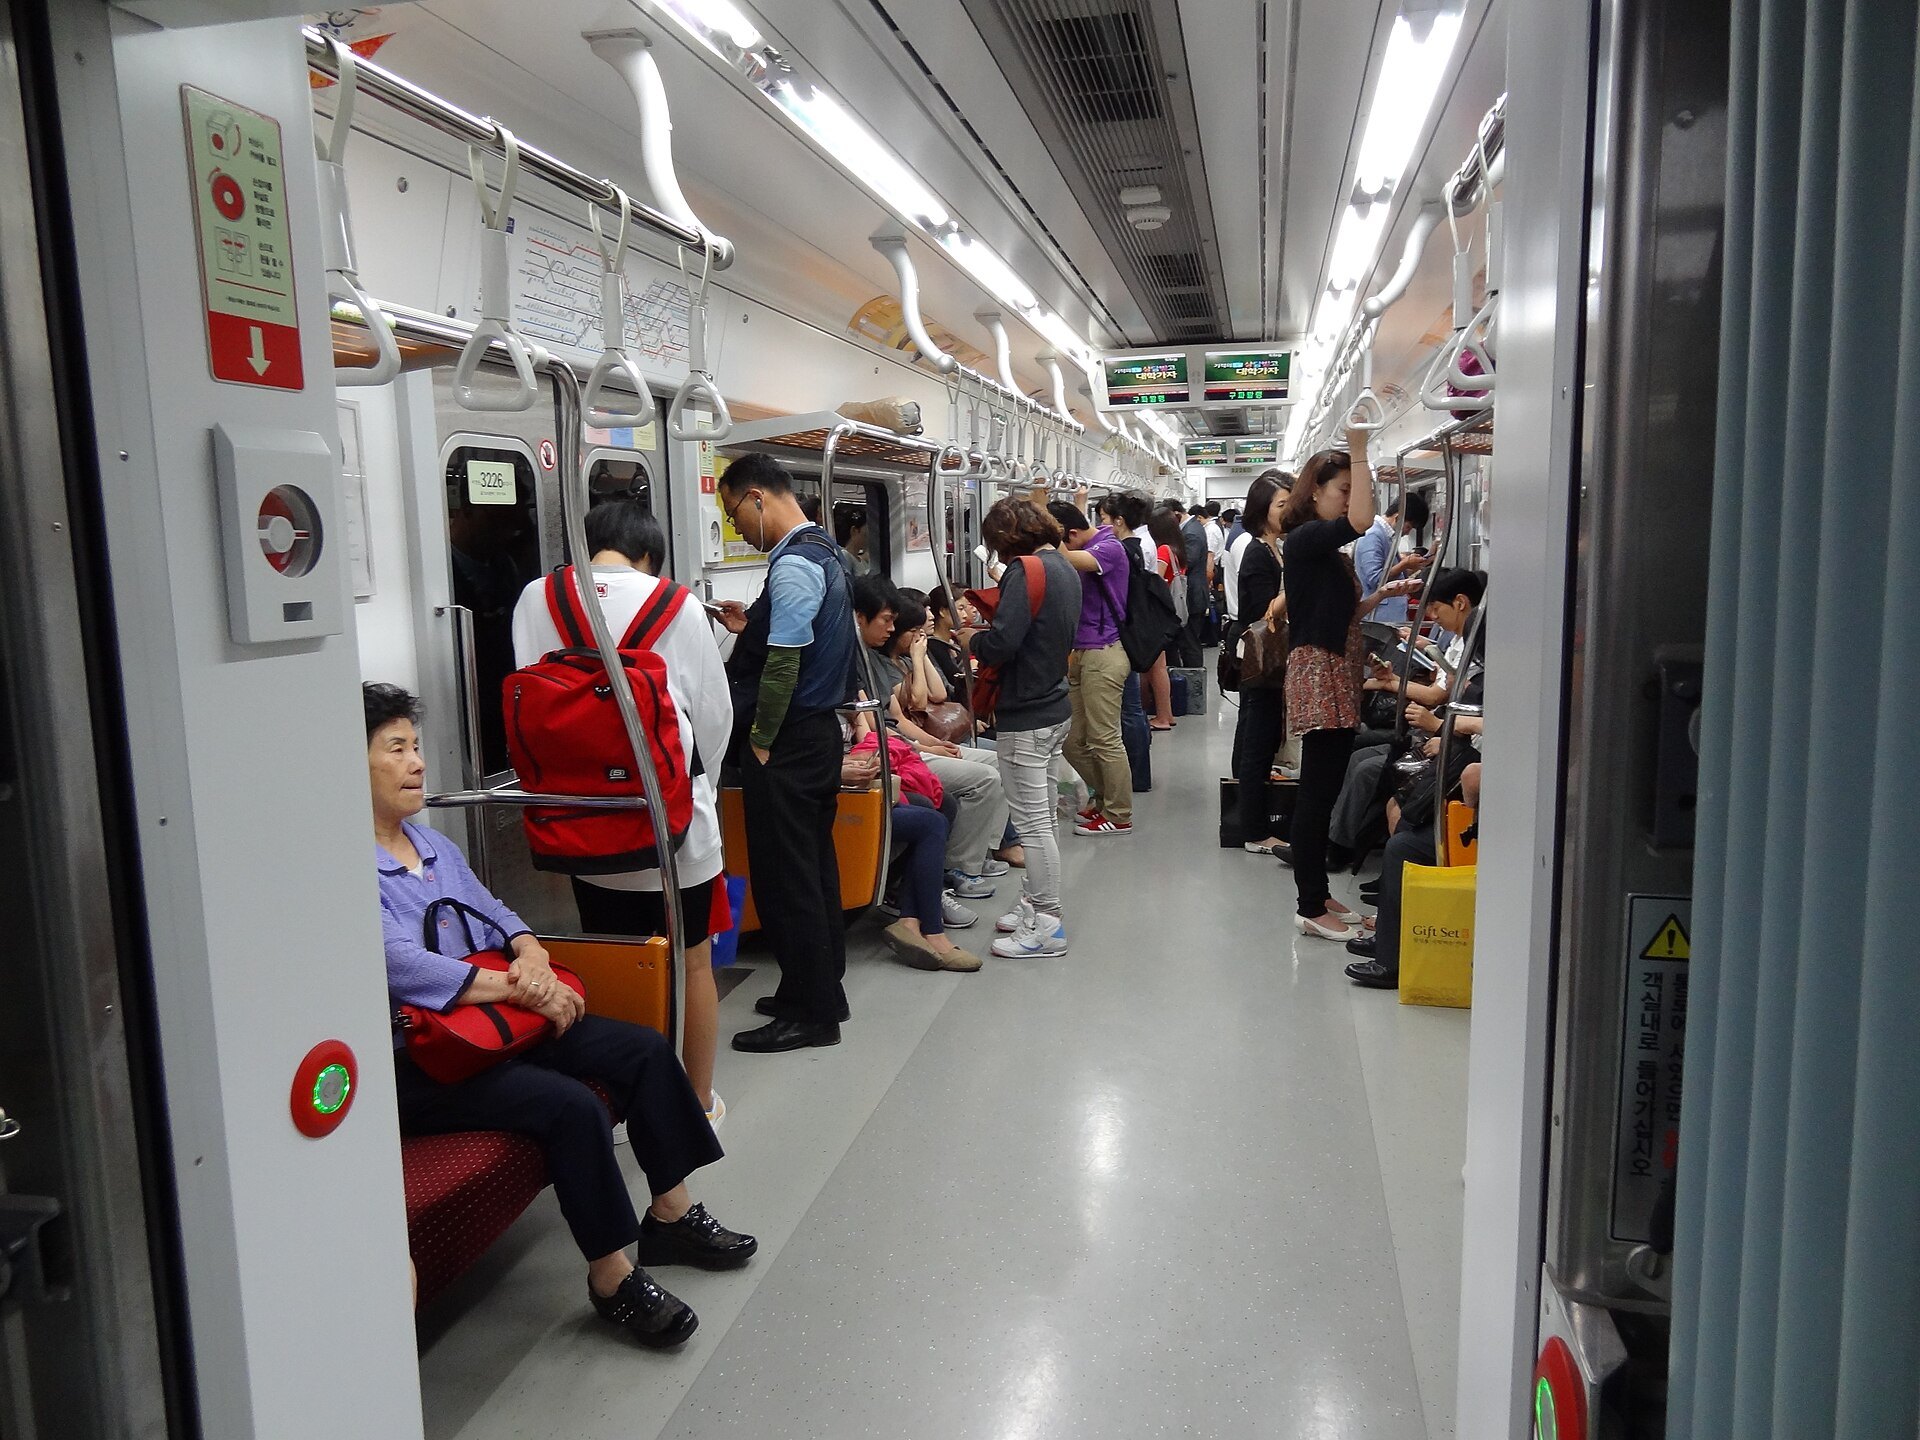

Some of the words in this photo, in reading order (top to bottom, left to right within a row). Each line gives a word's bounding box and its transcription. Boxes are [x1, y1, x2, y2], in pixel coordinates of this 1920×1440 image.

[1135, 370, 1178, 380] 대학가자
[1235, 366, 1280, 376] 대학가자
[480, 471, 504, 488] 3226
[1412, 925, 1437, 938] Gift
[1440, 927, 1460, 938] Set
